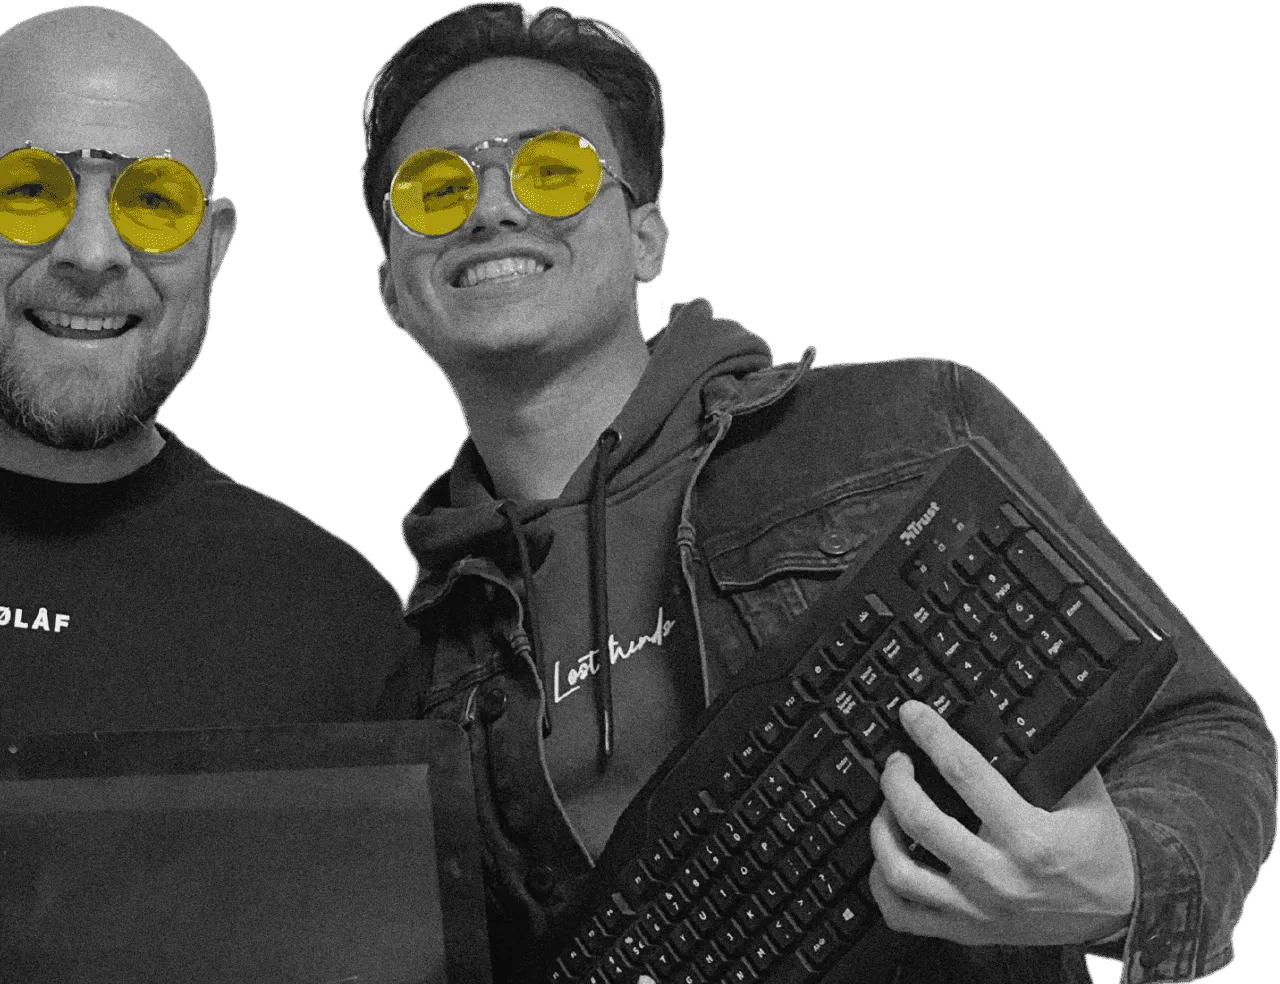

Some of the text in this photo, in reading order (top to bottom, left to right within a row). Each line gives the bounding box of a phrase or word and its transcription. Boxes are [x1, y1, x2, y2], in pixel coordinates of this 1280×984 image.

[964, 604, 971, 612] 8
[1016, 603, 1023, 611] 6
[938, 633, 944, 641] 7
[990, 632, 997, 641] 5
[1041, 631, 1049, 639] 3
[1016, 661, 1024, 669] 2
[553, 648, 601, 704] Lost
[1017, 717, 1025, 725] 0
[741, 867, 748, 875] O
[699, 911, 706, 920] U
[706, 955, 713, 963] H
[737, 971, 743, 980] N
